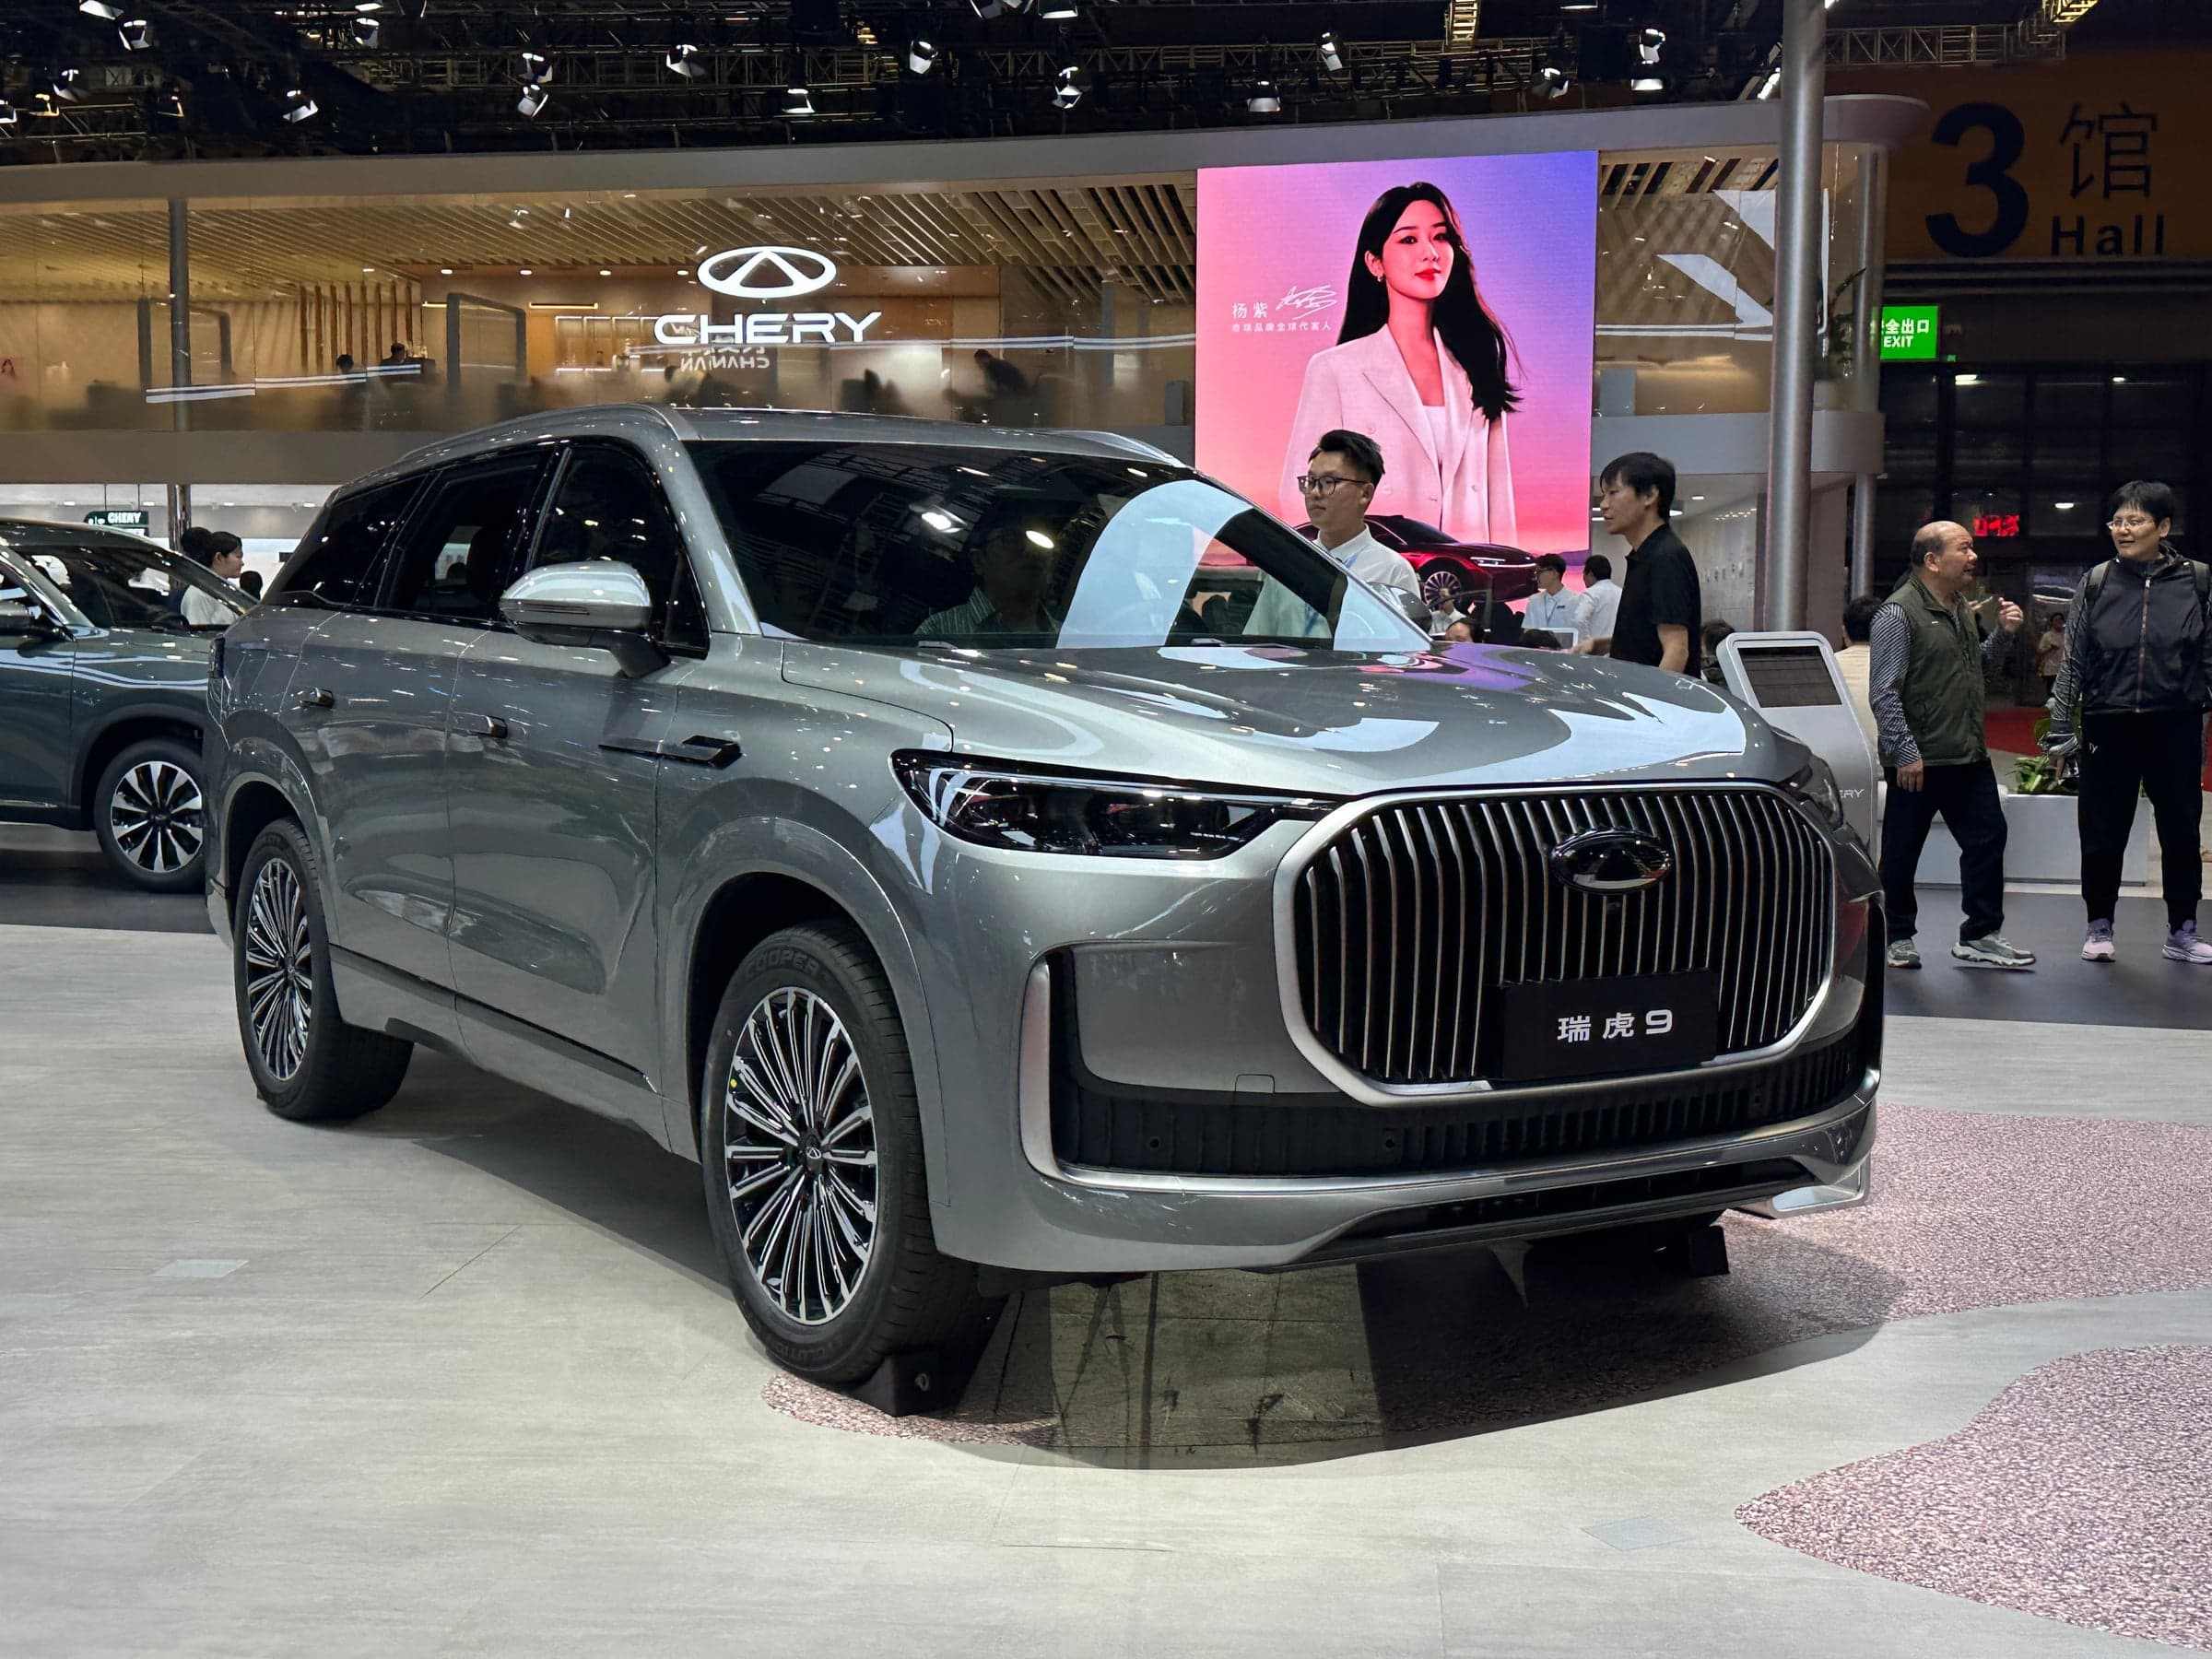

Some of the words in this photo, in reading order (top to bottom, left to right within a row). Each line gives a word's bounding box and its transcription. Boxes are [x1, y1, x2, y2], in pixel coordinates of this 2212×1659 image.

[2059, 102, 2159, 200] 馆
[1925, 100, 2029, 258] 3
[2051, 214, 2164, 257] Hall
[653, 312, 882, 345] CHERY
[1883, 335, 1914, 347] EXIT
[1839, 788, 1865, 799] ERY
[1557, 1009, 1673, 1043] 瑞虎9
